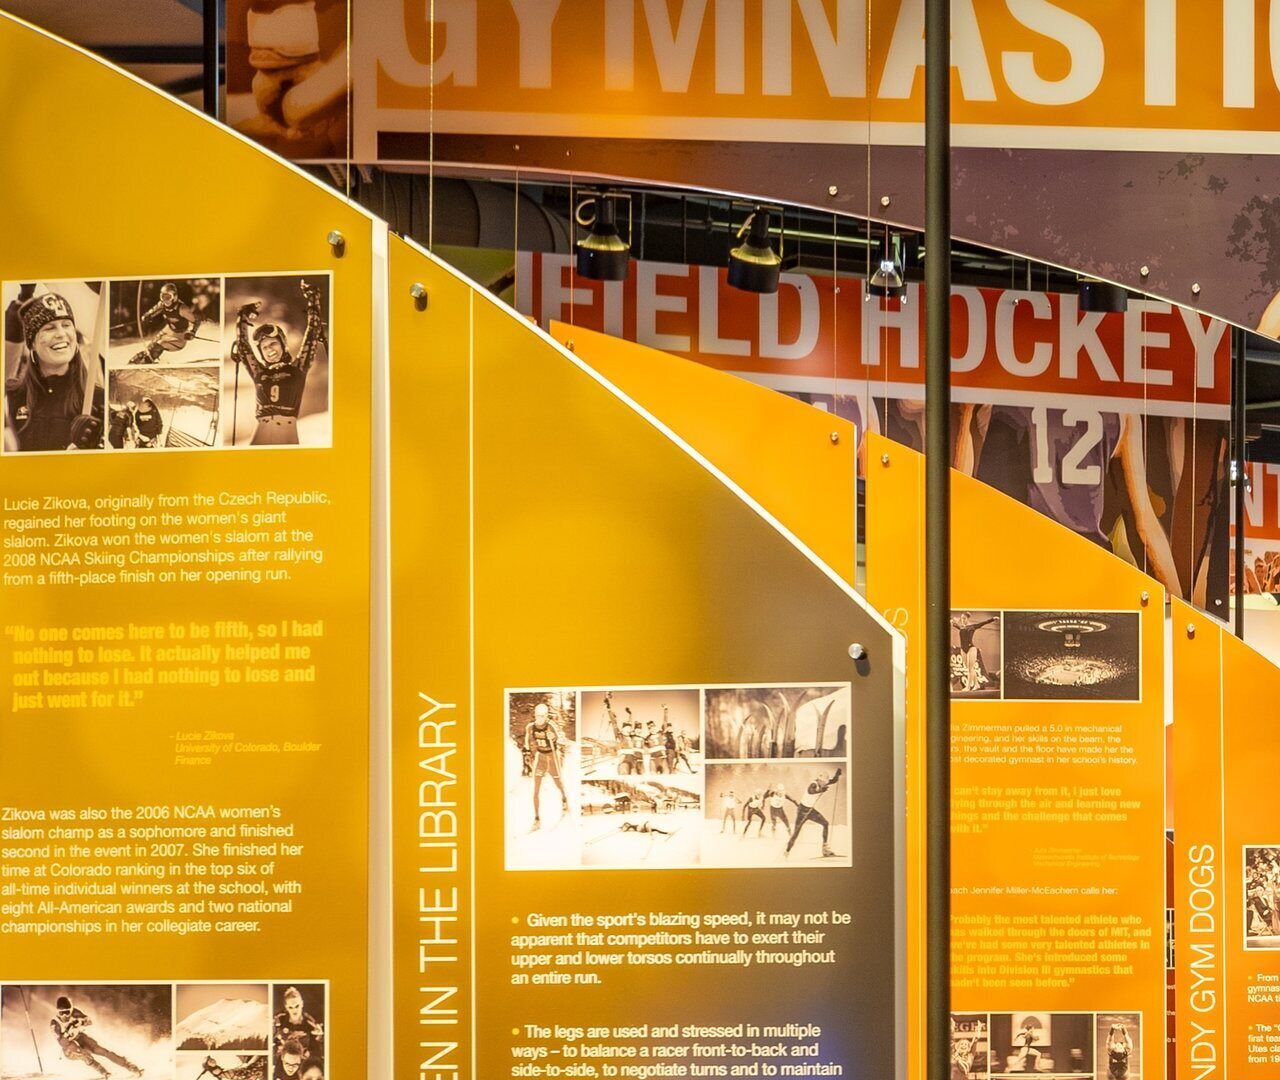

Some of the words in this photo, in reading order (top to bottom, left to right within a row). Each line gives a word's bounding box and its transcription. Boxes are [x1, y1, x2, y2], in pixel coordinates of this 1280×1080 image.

[541, 252, 820, 360] FIELD
[861, 281, 1229, 389] HOCKEY
[270, 385, 280, 403] 9
[1031, 408, 1104, 485] 12
[5, 494, 39, 511] Lucie
[44, 494, 91, 513] Zikova,
[95, 493, 153, 513] originally
[159, 492, 188, 509] from
[194, 492, 214, 508] the
[219, 491, 261, 508] Czech
[267, 490, 331, 511] Republic,
[4, 513, 60, 533] regained
[65, 512, 85, 529] her
[90, 511, 135, 532] footing
[140, 515, 157, 527] on
[162, 511, 182, 527] the
[187, 510, 248, 527] women's
[253, 509, 286, 530] giant
[4, 531, 51, 548] slalom.
[55, 531, 98, 547] Zikova
[103, 534, 130, 547] won
[135, 530, 155, 546] the
[160, 529, 221, 546] women's
[226, 528, 269, 545] slalom
[274, 528, 287, 544] at
[292, 528, 313, 544] the
[4, 551, 36, 567] 2008
[41, 550, 80, 567] NCAA
[85, 549, 125, 570] Skiing
[130, 548, 235, 569] Championships
[240, 548, 269, 564] after
[274, 547, 323, 568] rallying
[4, 569, 32, 586] from
[38, 573, 45, 585] a
[50, 568, 116, 589] fifth-place
[120, 568, 154, 584] finish
[159, 571, 176, 584] on
[181, 567, 201, 584] her
[207, 567, 260, 587] opening
[266, 570, 291, 583] run.
[419, 691, 457, 871] LIBRARY
[1189, 844, 1215, 935] DOGS
[420, 887, 458, 974] THE
[527, 911, 567, 927] Given
[571, 911, 593, 927] the
[597, 911, 646, 930] sport's
[650, 911, 700, 930] blazing
[704, 911, 752, 930] speed,
[757, 911, 766, 926] it
[770, 914, 800, 930] may
[805, 910, 828, 926] not
[832, 910, 851, 925] be
[511, 930, 573, 949] apparent
[577, 930, 604, 945] that
[607, 930, 692, 949] competitors
[696, 929, 730, 945] have
[734, 929, 748, 945] to
[752, 929, 789, 944] exert
[793, 929, 824, 944] their
[512, 953, 552, 969] upper
[556, 949, 582, 965] and
[586, 949, 623, 964] lower
[628, 949, 672, 964] torsos
[676, 949, 752, 968] continually
[756, 948, 835, 967] throughout
[512, 972, 529, 984] an
[532, 969, 571, 984] entire
[574, 972, 601, 984] run.
[1190, 944, 1216, 1014] GYM
[1257, 972, 1278, 982] From
[420, 986, 458, 1025] IN
[1248, 993, 1273, 1003] NCAA
